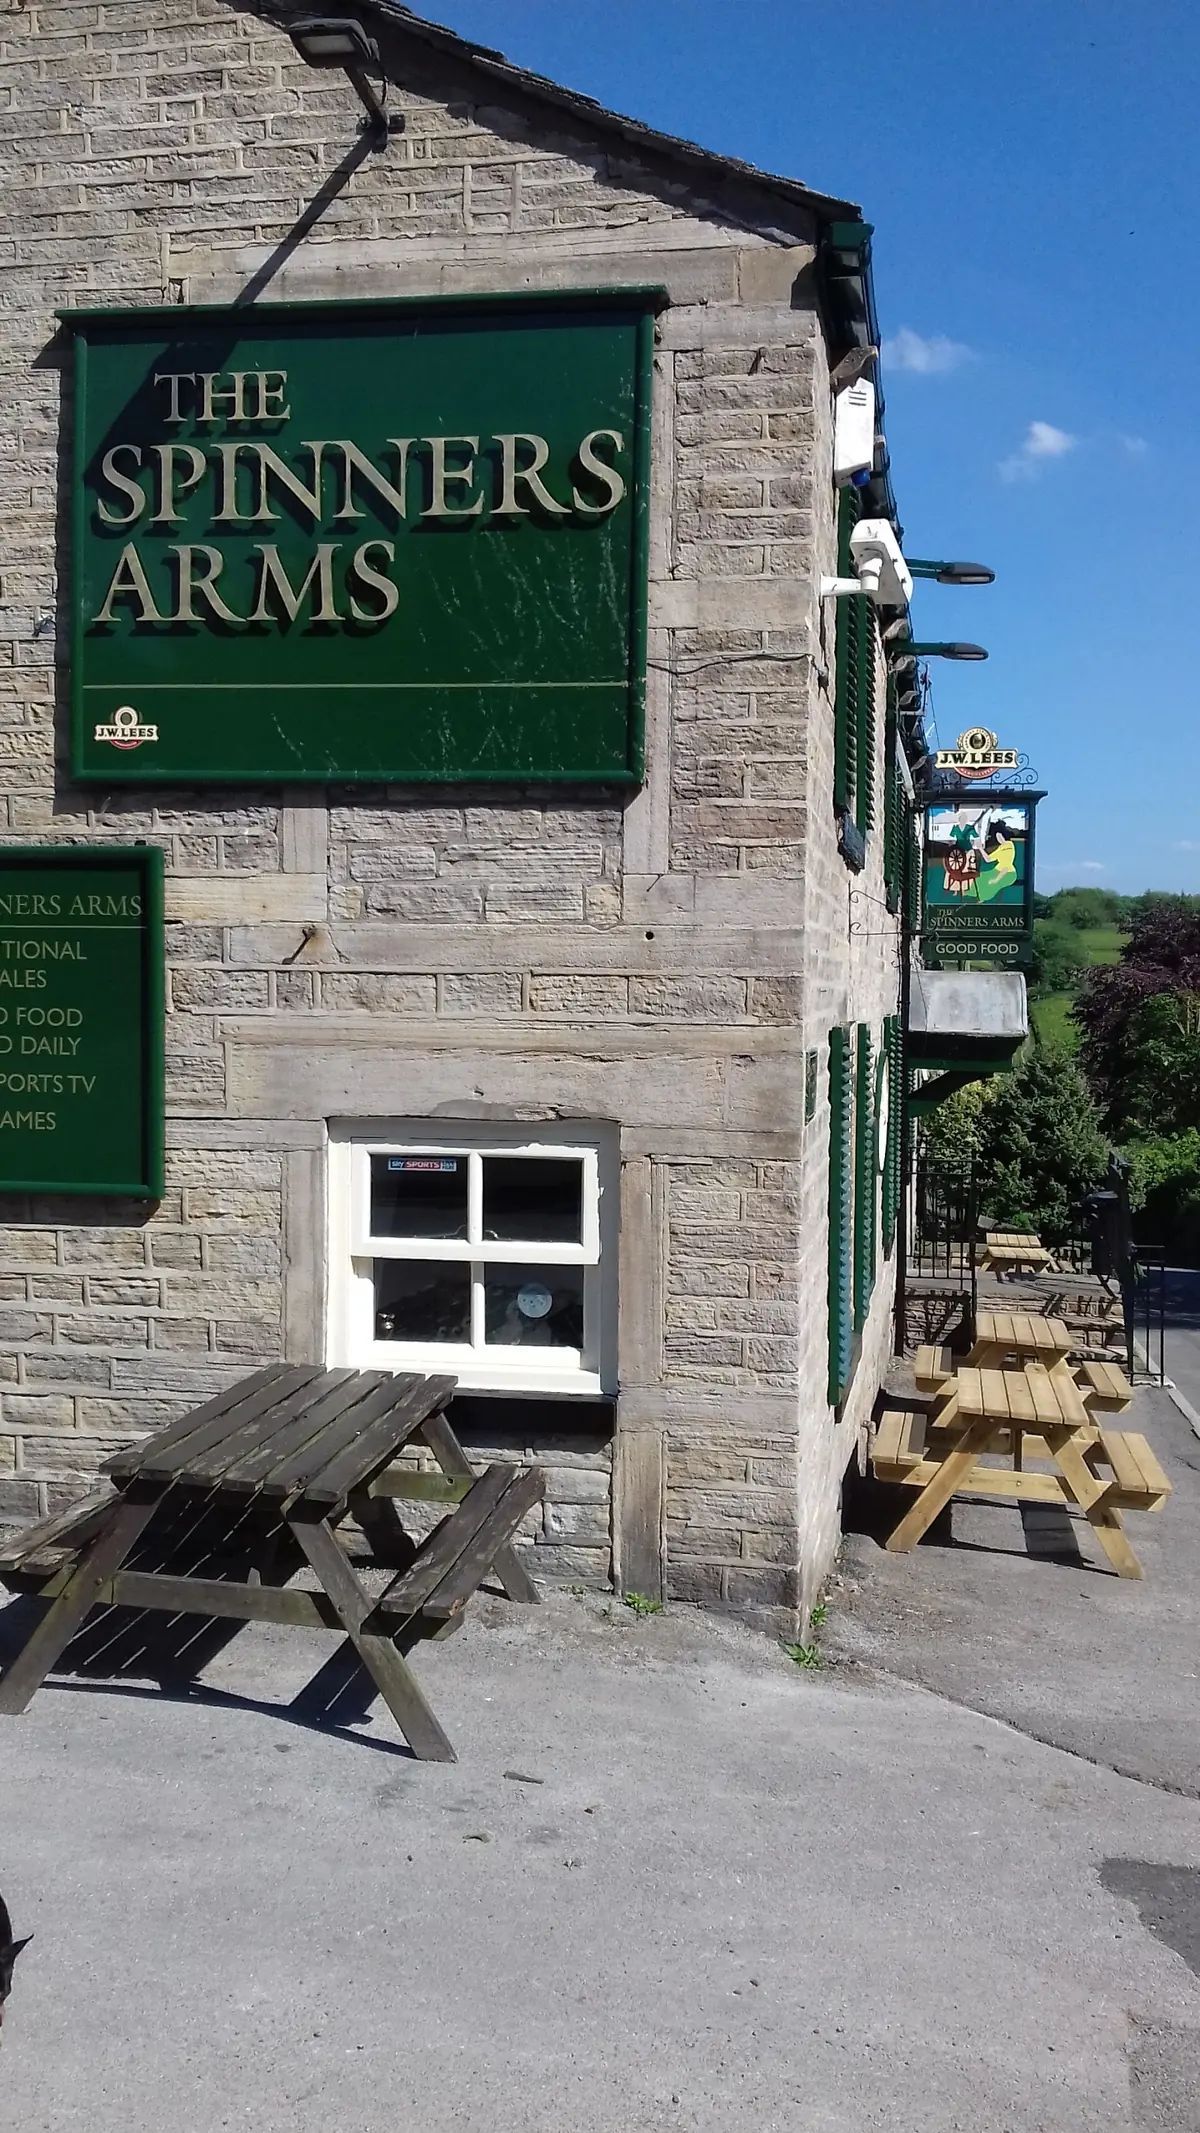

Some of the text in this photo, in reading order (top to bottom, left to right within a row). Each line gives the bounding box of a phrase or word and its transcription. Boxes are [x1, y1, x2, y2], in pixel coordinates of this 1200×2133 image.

[153, 370, 291, 423] THE
[96, 430, 627, 525] SPINNERS
[91, 540, 400, 623] ARMS
[68, 895, 143, 917] ARMS
[930, 916, 1025, 928] SPINNERS ARMS
[1, 940, 88, 960] TIONAL
[935, 943, 1019, 955] GOOD FOOD
[16, 1006, 83, 1027] FOOD
[21, 1036, 82, 1056] DAILY
[66, 1075, 97, 1094] TV
[406, 1161, 440, 1169] SPORTS
